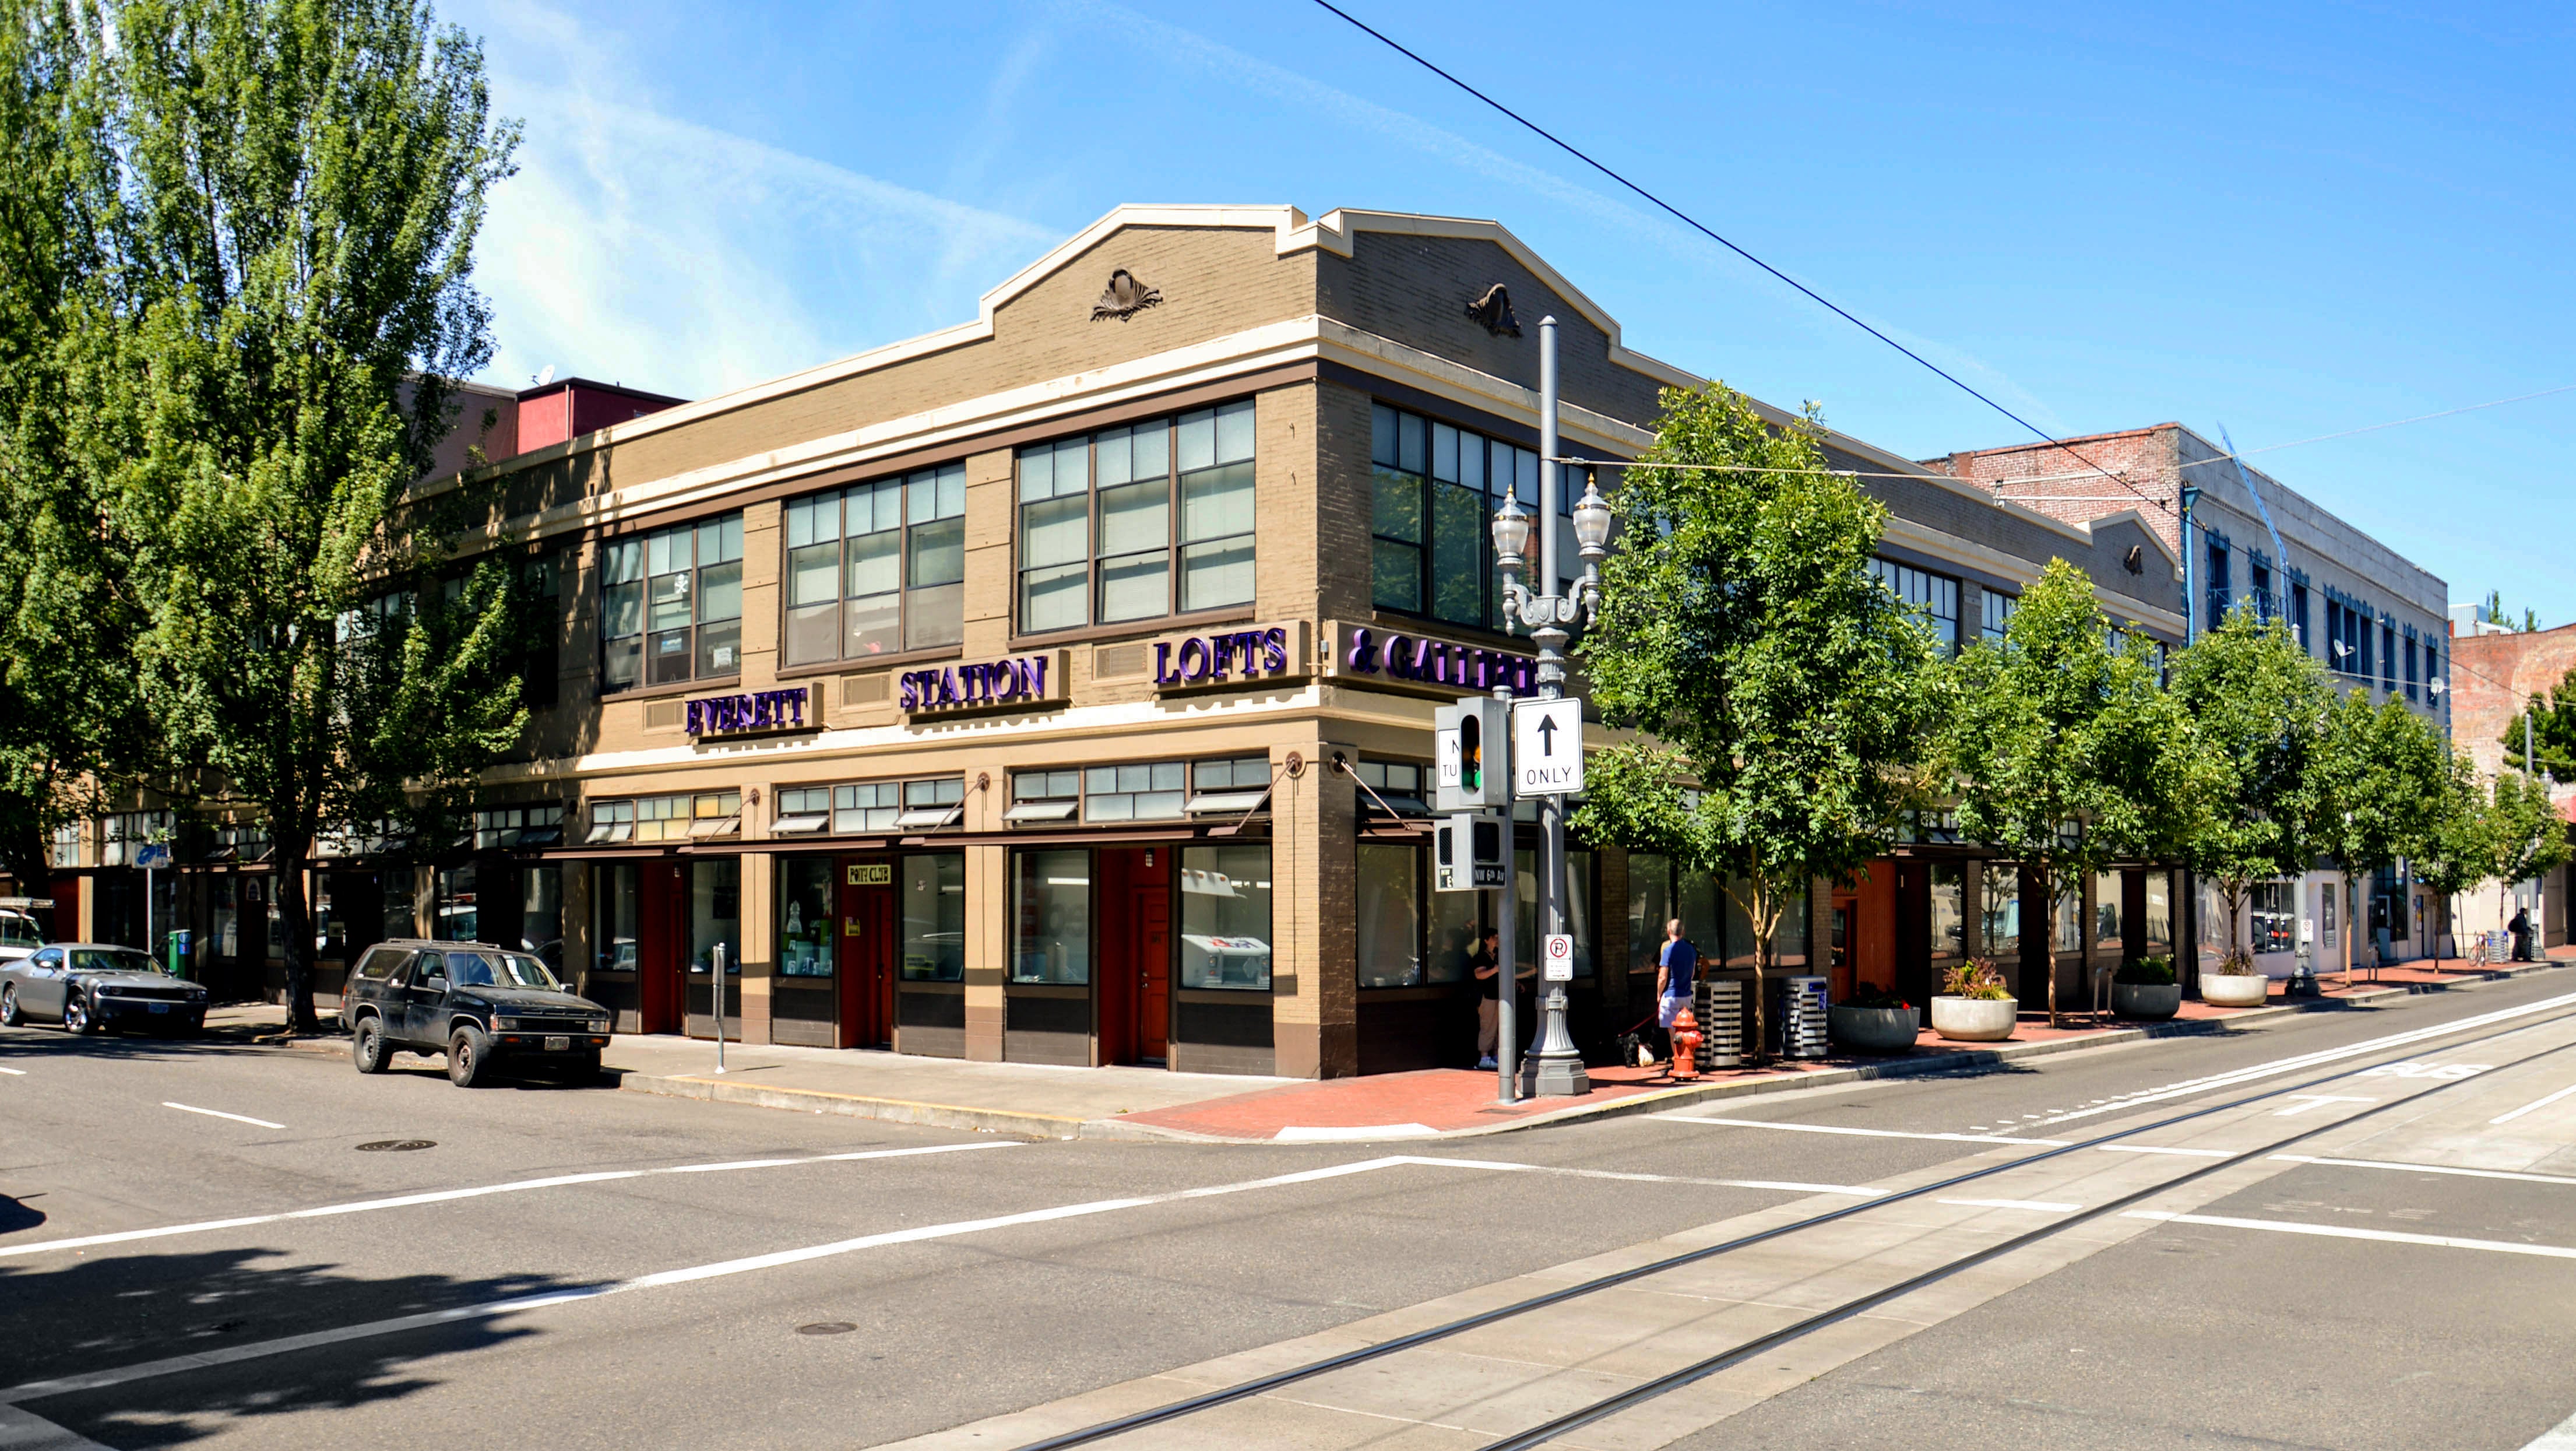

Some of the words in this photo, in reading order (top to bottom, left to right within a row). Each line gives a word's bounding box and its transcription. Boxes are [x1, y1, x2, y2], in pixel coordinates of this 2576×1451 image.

[1348, 628, 1380, 673] &
[1384, 635, 1564, 698] GALLERI
[685, 687, 808, 733] EVERETT
[900, 656, 1048, 709] STATION
[1153, 628, 1287, 683] LOFTS
[1526, 767, 1571, 785] ONLY
[850, 867, 868, 883] PONY
[870, 866, 888, 882] CLUB
[1474, 869, 1485, 881] NW
[1497, 869, 1505, 881] Av
